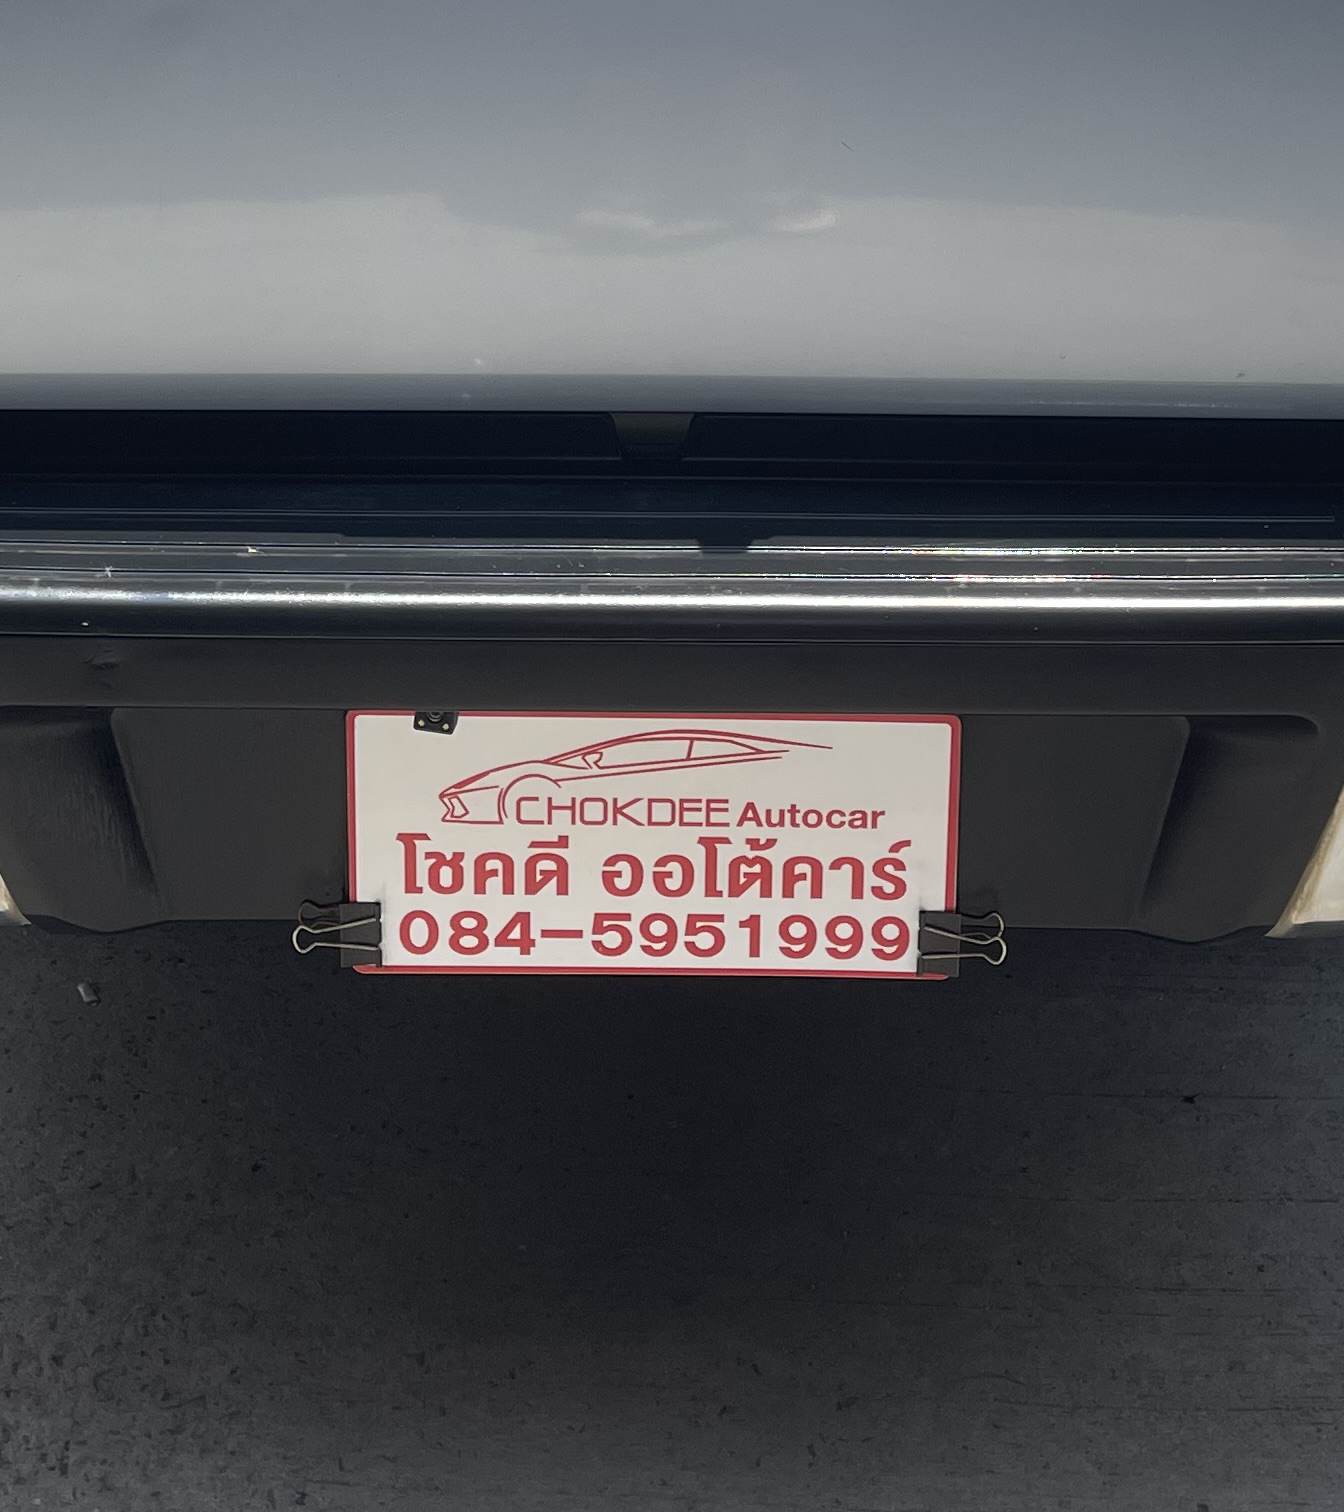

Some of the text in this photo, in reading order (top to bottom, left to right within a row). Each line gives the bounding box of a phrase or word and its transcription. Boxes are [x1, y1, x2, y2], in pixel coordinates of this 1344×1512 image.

[514, 796, 887, 830] CHOKDEE Autocar
[395, 832, 913, 901] โชคดี ออโต้คาร์
[398, 909, 912, 961] 084-5951999
